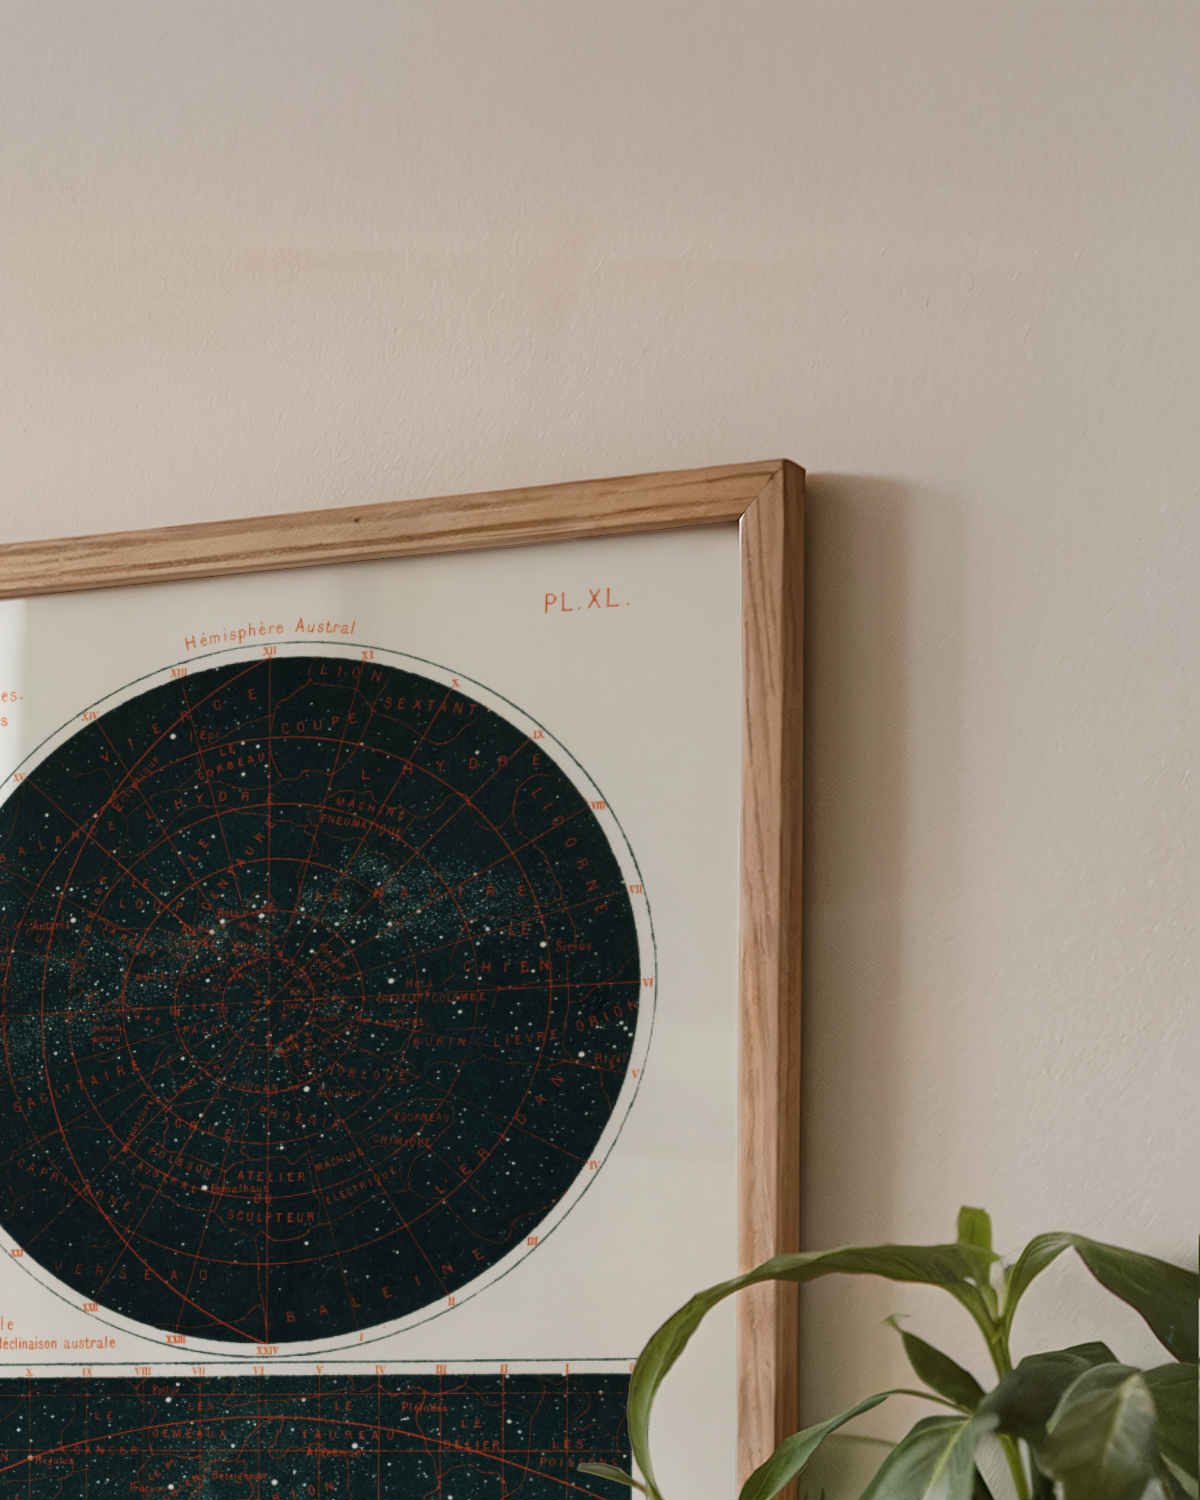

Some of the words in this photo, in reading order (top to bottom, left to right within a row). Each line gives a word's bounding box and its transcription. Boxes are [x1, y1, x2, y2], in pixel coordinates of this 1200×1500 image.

[184, 621, 283, 651] Hémisphère
[295, 617, 356, 635] Austral
[170, 668, 187, 678] XIII
[320, 663, 383, 683] LION
[383, 697, 479, 715] SEXTANT
[281, 712, 358, 734] COUPE
[219, 744, 236, 757] LE
[198, 752, 265, 781] CORBEAU
[335, 797, 406, 819] MACHINE
[320, 813, 403, 838] PNEUMATIQUE
[315, 888, 342, 901] LE
[373, 885, 527, 899] NAVIRE
[508, 923, 530, 936] LE
[554, 940, 593, 952] Sirius
[463, 959, 550, 973] CHIEN
[575, 999, 639, 1032] ORION
[594, 1052, 626, 1070] Rigel
[237, 1170, 305, 1183] ATELIER
[16, 1158, 131, 1212] CAPRICORNE
[226, 1209, 315, 1223] SCULPTEUR
[188, 1402, 214, 1411] LES
[334, 1401, 353, 1411] LE
[95, 1411, 113, 1420] LE
[302, 1429, 396, 1440] TAUREAU
[73, 1445, 138, 1455] CANCER
